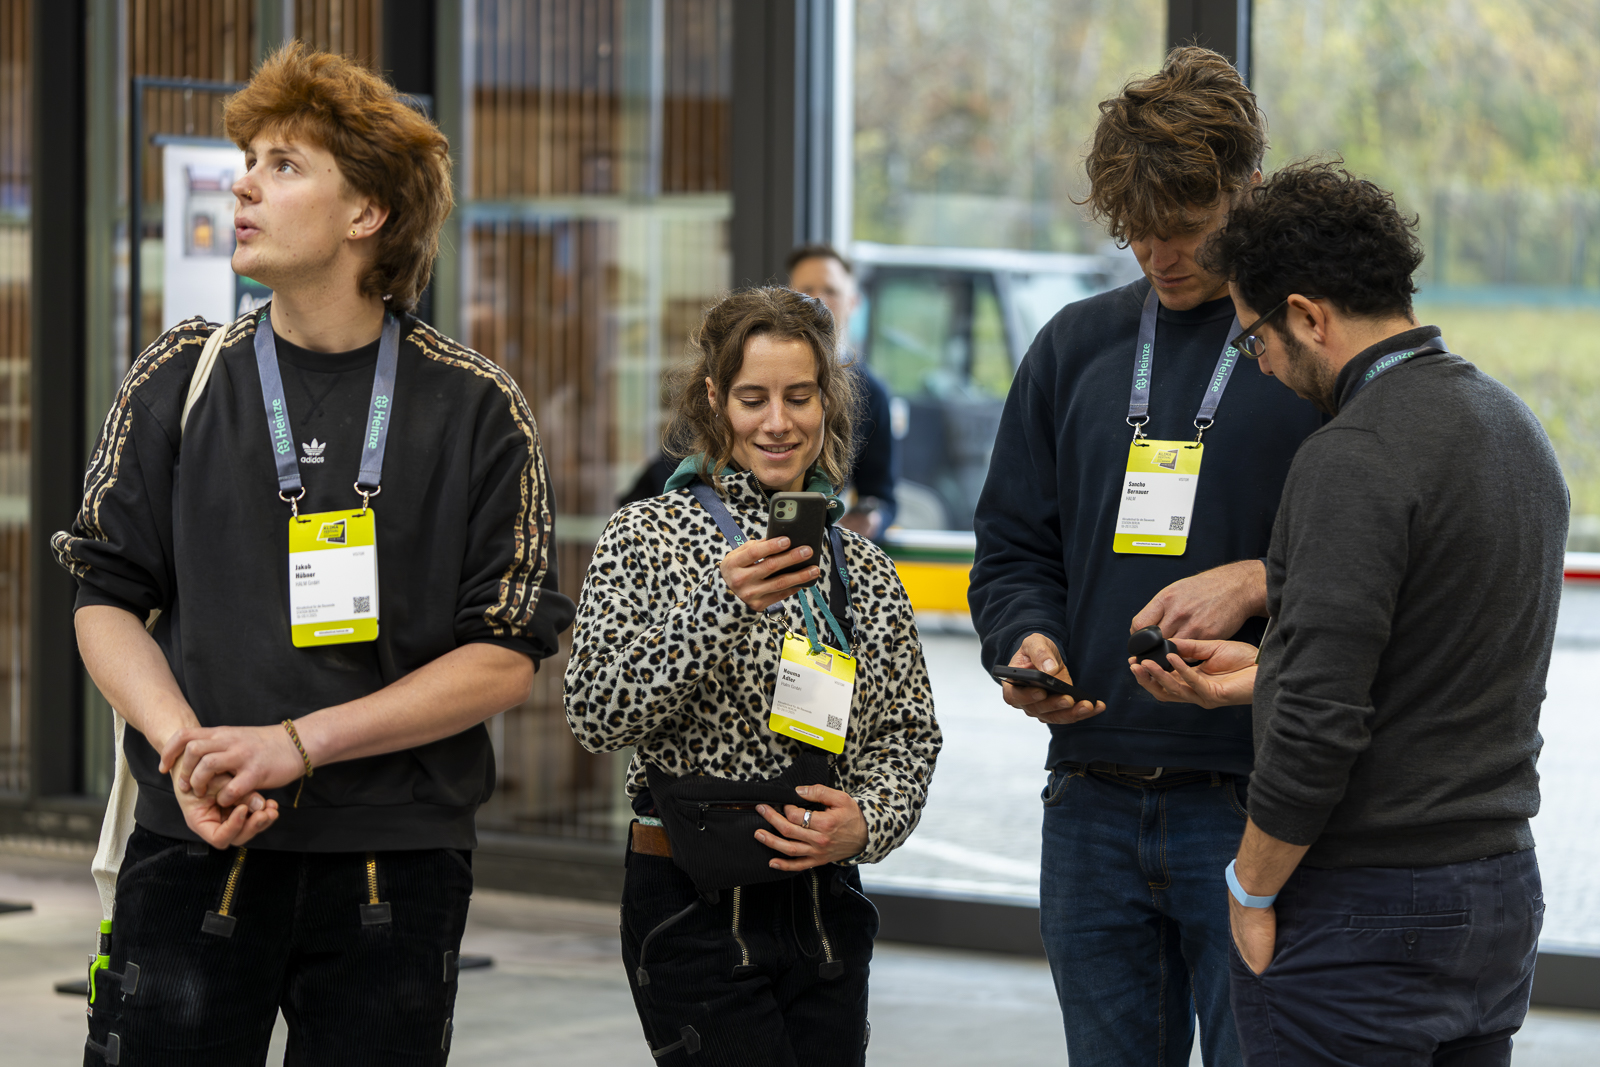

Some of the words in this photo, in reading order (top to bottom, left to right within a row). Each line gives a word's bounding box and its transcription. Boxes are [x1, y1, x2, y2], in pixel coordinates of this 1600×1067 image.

[1137, 343, 1151, 377] Heinze
[1211, 358, 1233, 392] Heinze
[1375, 351, 1415, 372] Heinze
[272, 398, 287, 440] Heinze
[368, 410, 386, 449] Heinze
[300, 456, 325, 464] adidas
[782, 674, 796, 683] Adler
